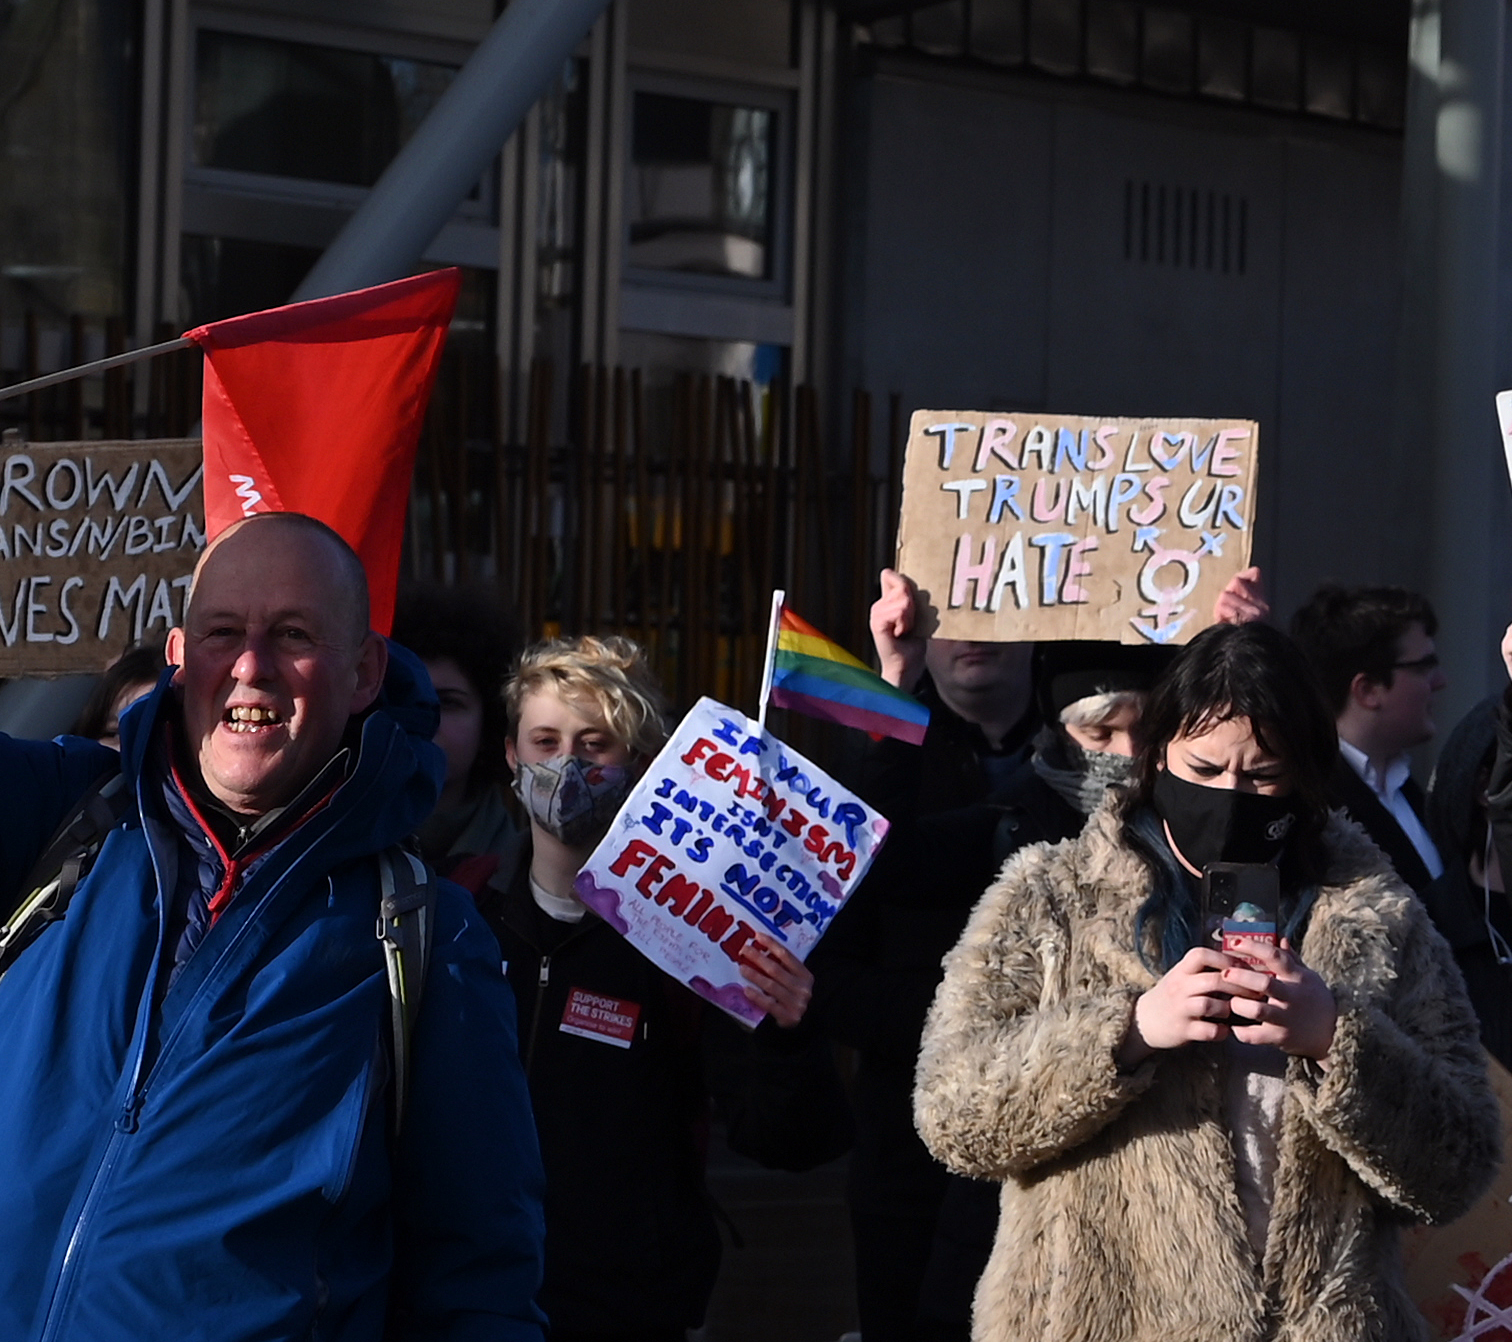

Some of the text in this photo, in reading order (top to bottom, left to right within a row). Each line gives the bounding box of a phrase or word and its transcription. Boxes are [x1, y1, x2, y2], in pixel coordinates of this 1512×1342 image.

[924, 419, 1250, 477] TRANS LOVE
[940, 474, 1247, 533] TRUMPS UR
[948, 531, 1099, 612] HATE
[97, 574, 192, 646] MAT
[681, 737, 855, 881] FEMINISM
[712, 718, 867, 850] IF YOUR
[642, 802, 803, 927] IT'S NOT
[609, 839, 783, 971] FEMINI
[571, 1002, 634, 1027] THE STRIKES
[572, 991, 620, 1011] SUPPORT
